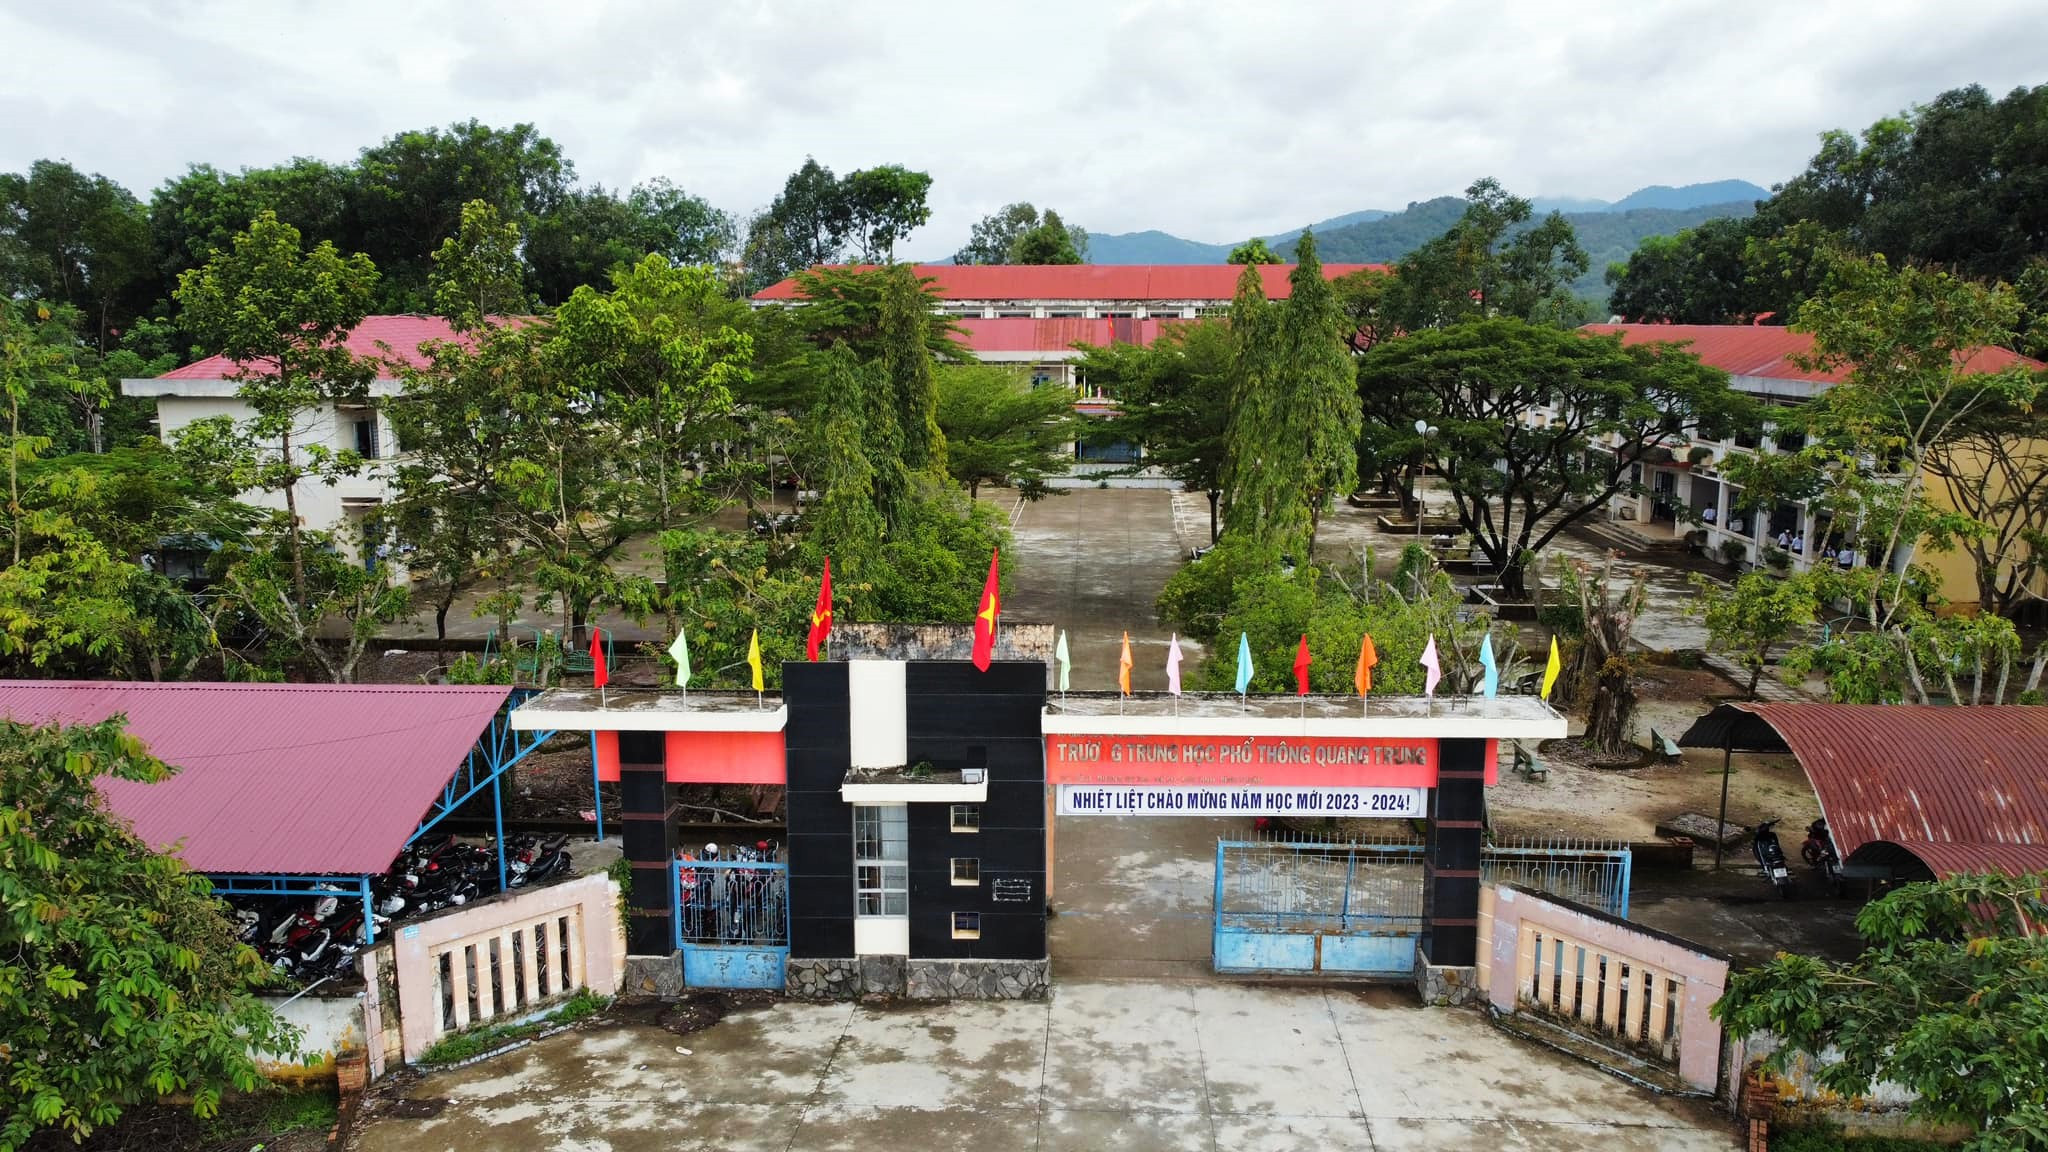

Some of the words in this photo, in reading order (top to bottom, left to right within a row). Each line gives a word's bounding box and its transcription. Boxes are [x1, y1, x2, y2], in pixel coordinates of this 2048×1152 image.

[1127, 744, 1179, 763] TRUNG
[1183, 744, 1216, 766] HỌC
[1219, 736, 1255, 763] PHỔ
[1257, 741, 1311, 764] THÔNG
[1315, 746, 1370, 767] QUANG
[1373, 746, 1427, 766] TRUNG
[1073, 788, 1113, 813] NHIỆT
[1116, 788, 1144, 813] LIỆT
[1149, 789, 1183, 809] CHÀO
[1187, 789, 1227, 809] MỪNG
[1231, 789, 1262, 810] NĂM
[1266, 792, 1292, 813] HỌC
[1296, 789, 1322, 810] MỚI
[1326, 793, 1359, 810] 2023
[1371, 793, 1410, 811] 2024!
